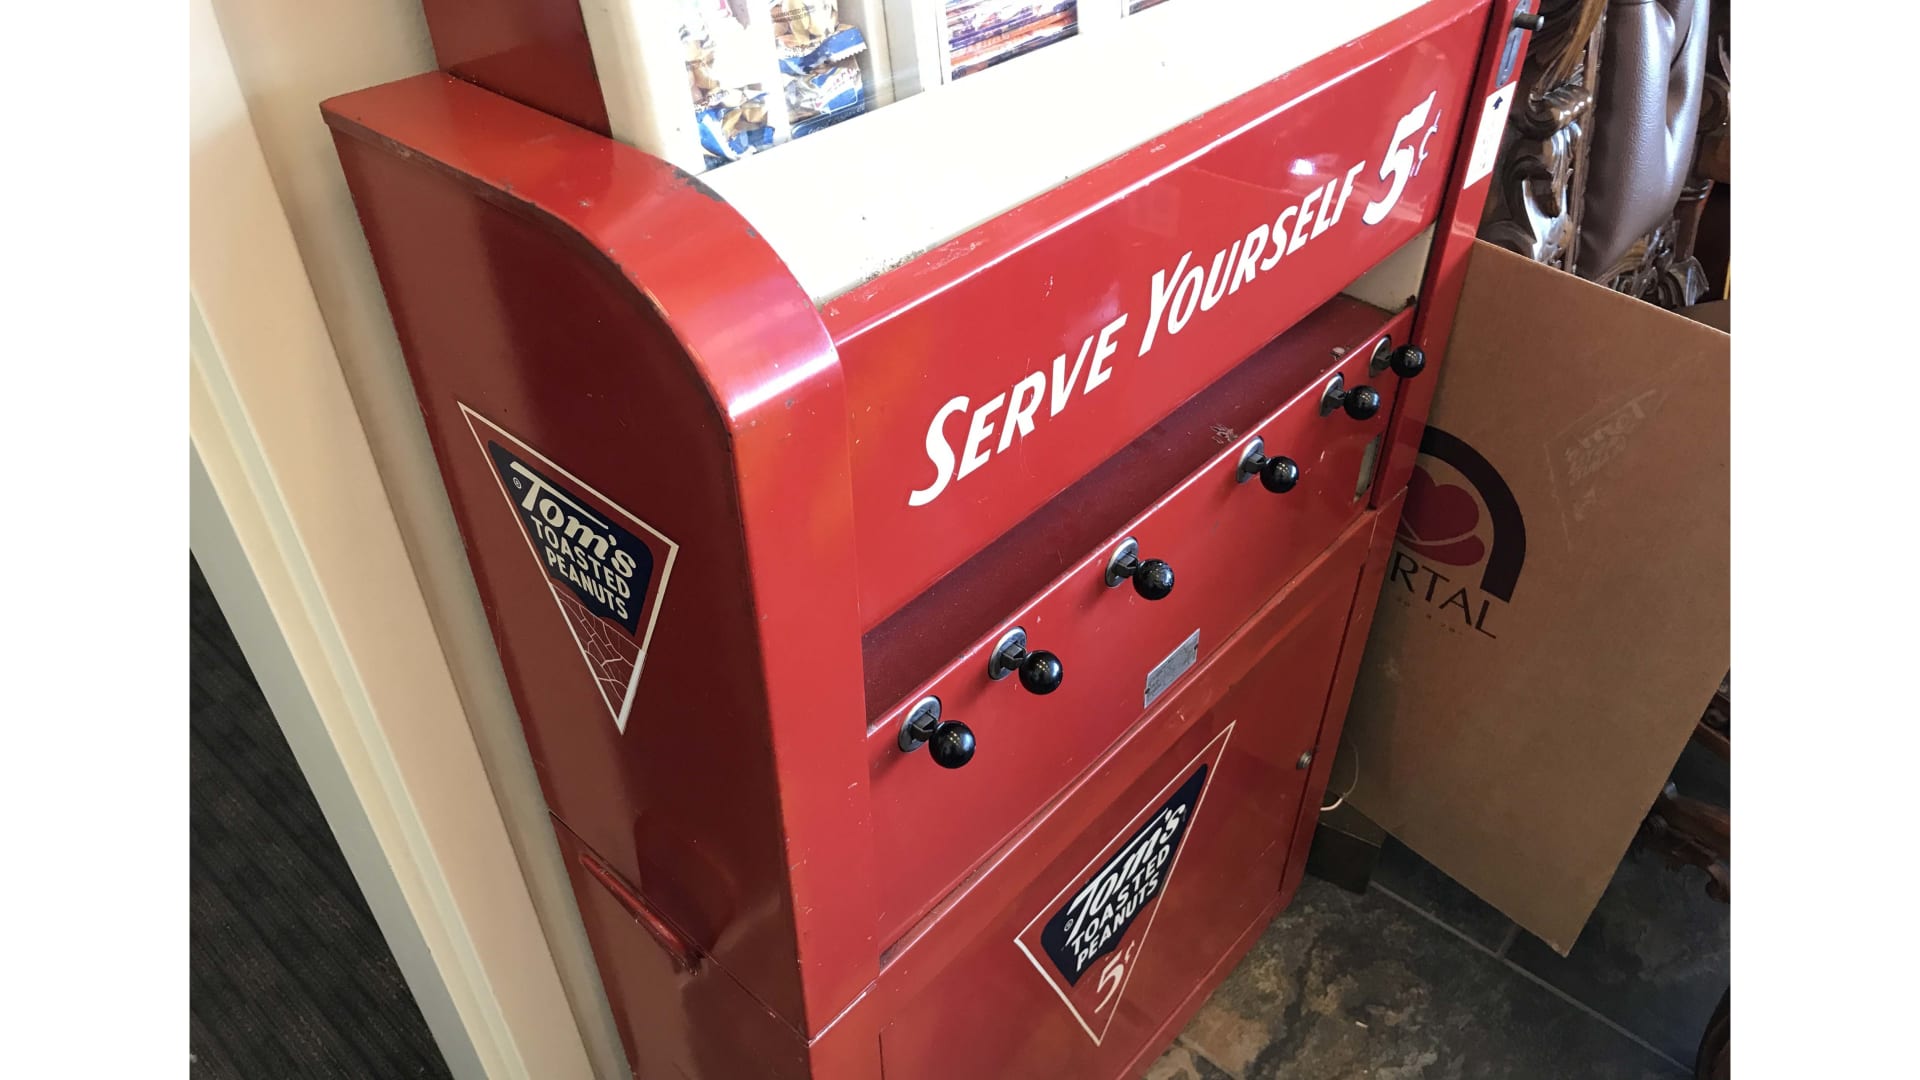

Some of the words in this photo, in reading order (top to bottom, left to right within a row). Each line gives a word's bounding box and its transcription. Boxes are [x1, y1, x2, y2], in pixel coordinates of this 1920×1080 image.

[907, 312, 1128, 507] SERVE
[1139, 160, 1366, 358] YOURSELF
[509, 460, 637, 579] Tom's
[530, 515, 631, 600] TOASTED
[547, 547, 628, 620] PEANUTS
[1064, 802, 1187, 947] Tom's
[1071, 843, 1171, 956] TOASTED
[1075, 875, 1159, 972] PEANUTS
